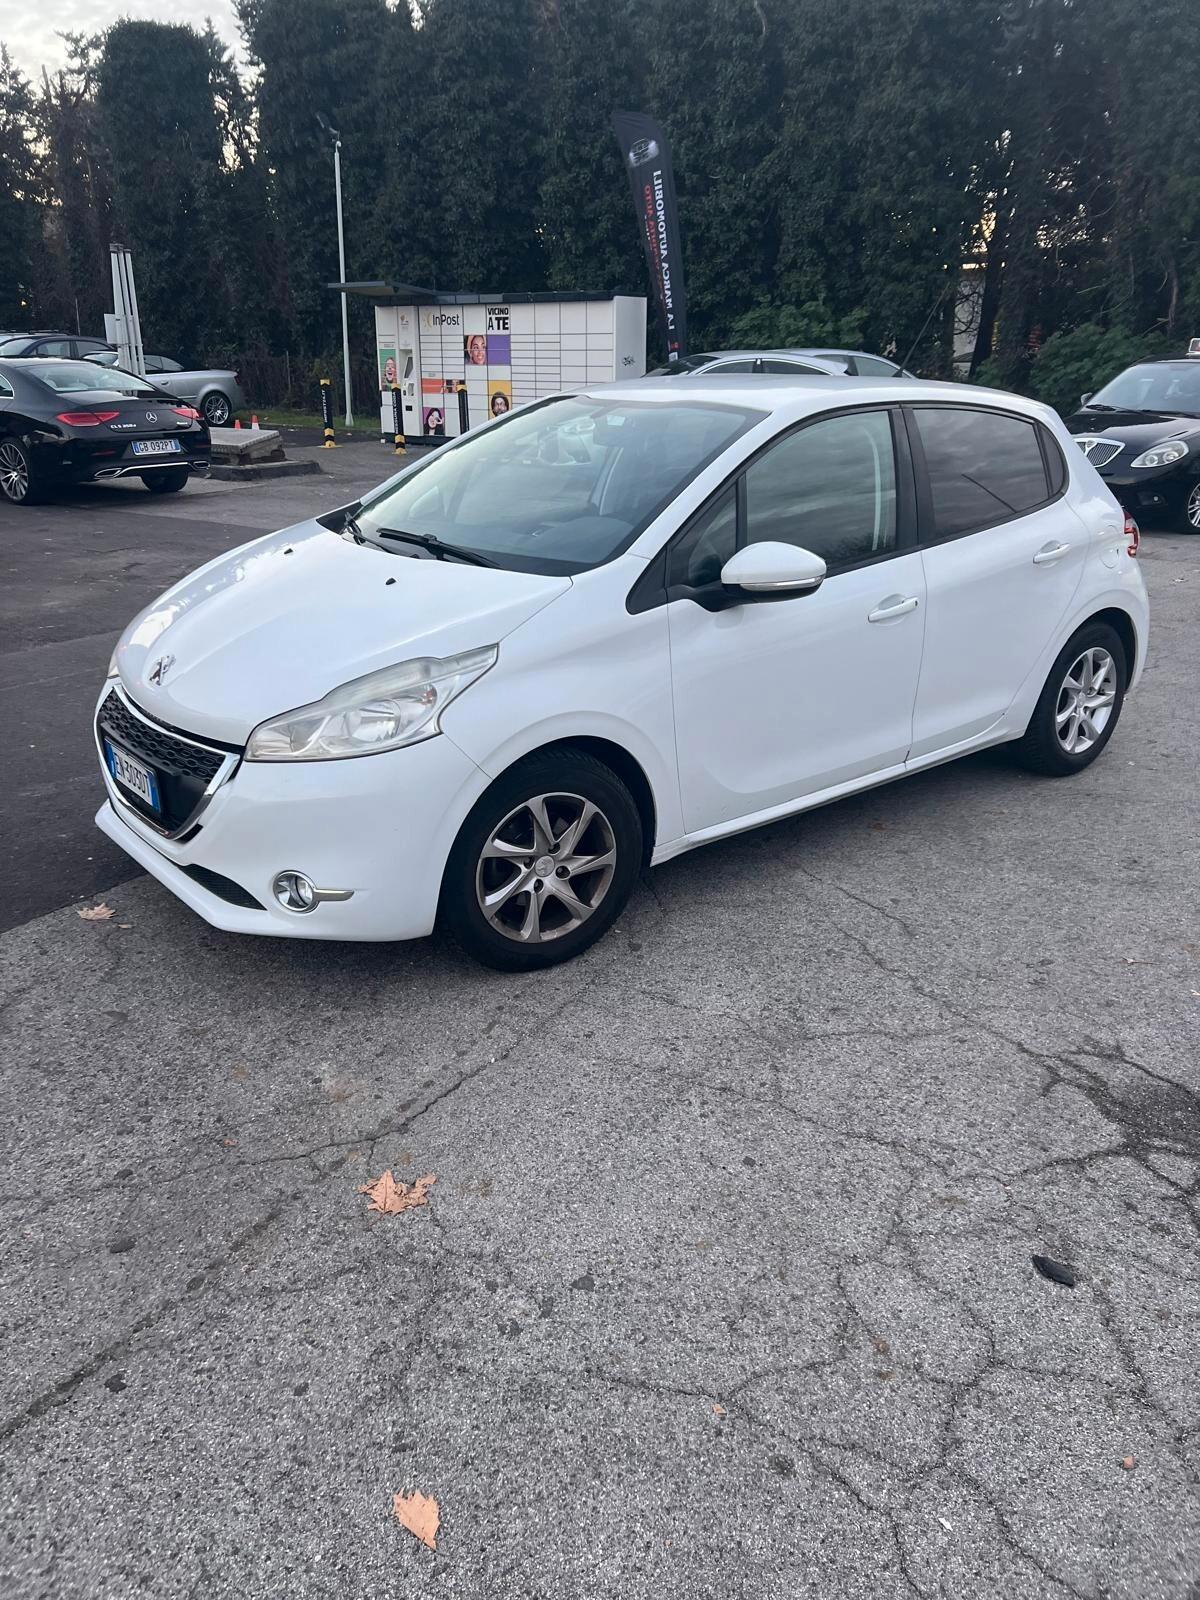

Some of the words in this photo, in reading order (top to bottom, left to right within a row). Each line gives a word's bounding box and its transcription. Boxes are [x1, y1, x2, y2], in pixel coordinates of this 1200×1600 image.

[487, 307, 509, 316] VICINO
[432, 313, 460, 326] InPost
[487, 317, 494, 331] A
[495, 316, 510, 331] TE
